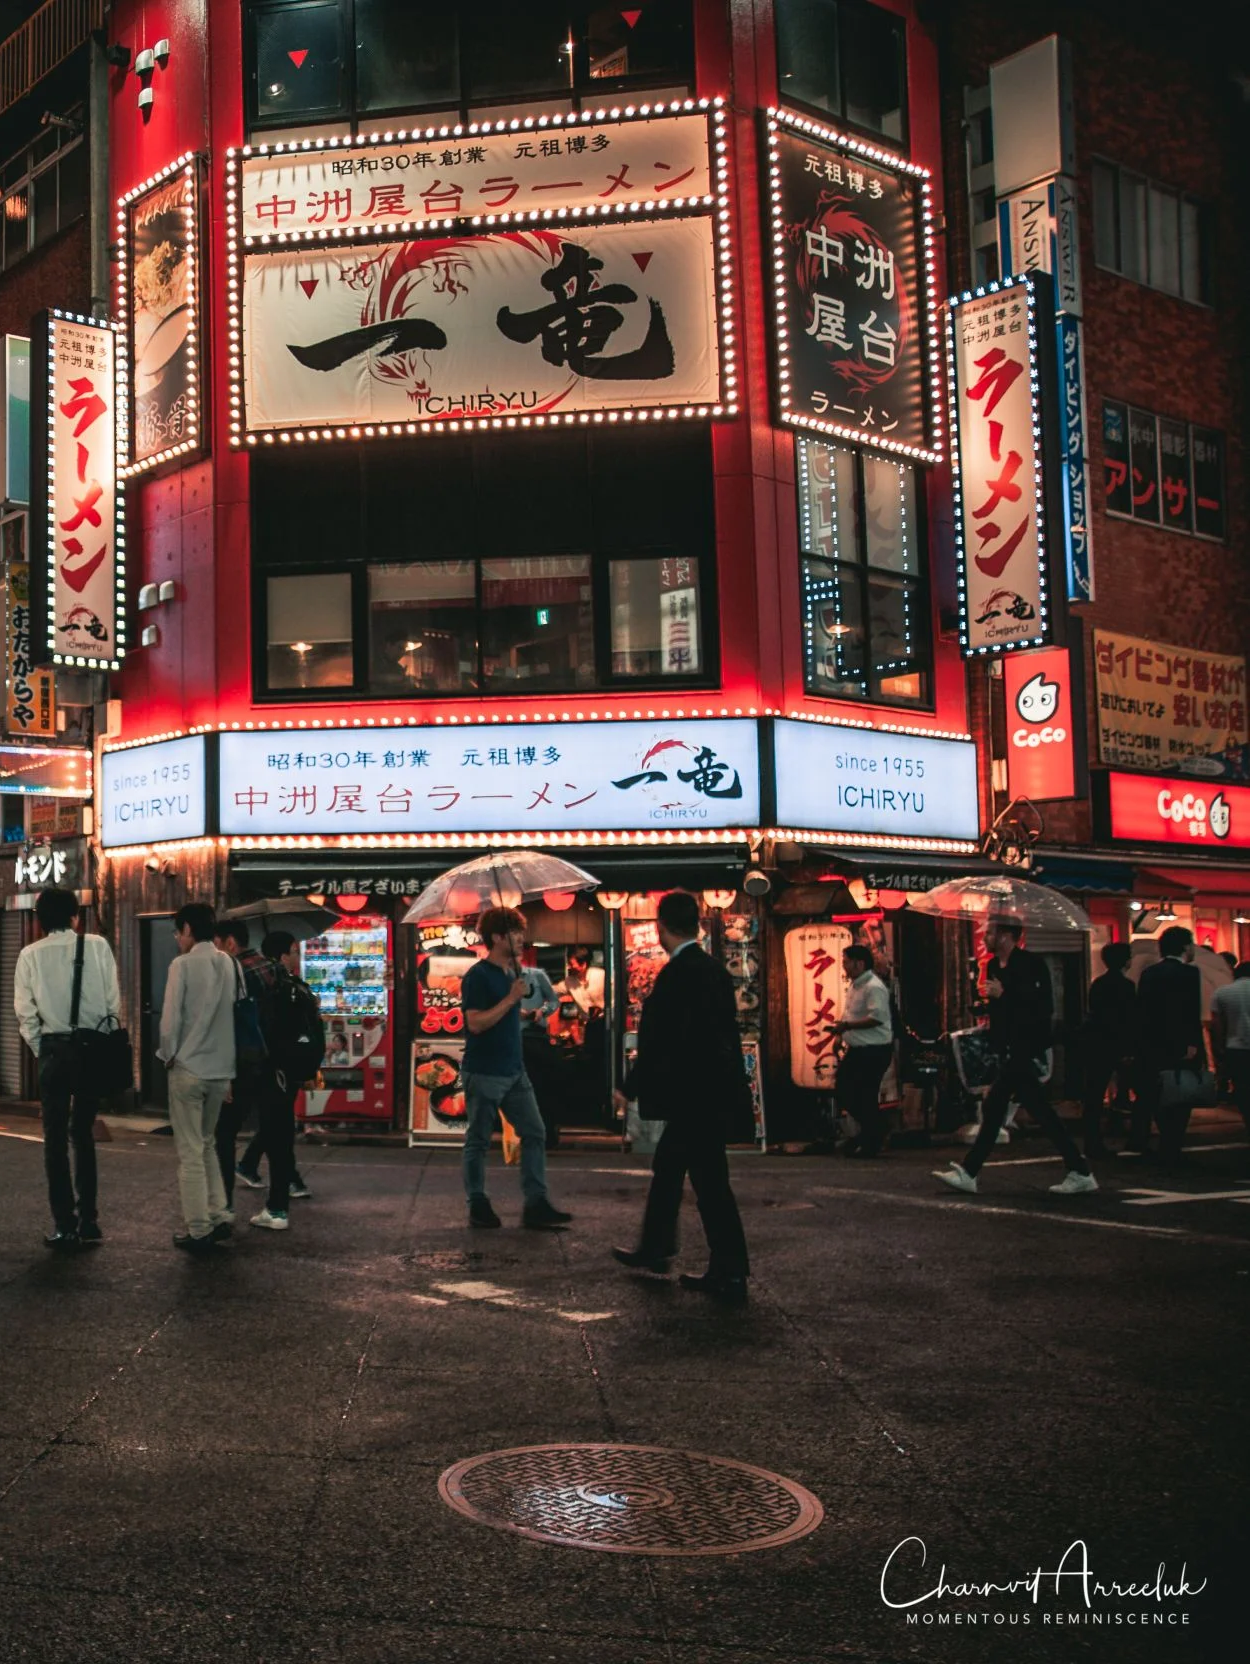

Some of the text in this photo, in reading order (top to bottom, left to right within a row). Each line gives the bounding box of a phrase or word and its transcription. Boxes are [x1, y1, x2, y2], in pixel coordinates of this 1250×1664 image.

[331, 131, 613, 176] 昭和30年創業 元祖博多
[255, 159, 697, 229] 中洲屋台ラーメン
[803, 153, 885, 201] 元祖博多
[805, 224, 896, 301] 中洲
[286, 241, 677, 381] 一竜
[805, 291, 897, 368] 屋台
[963, 304, 1022, 333] 元祖博多
[59, 338, 108, 358] 元祖博多
[962, 319, 1022, 347] 中洲屋台
[59, 353, 108, 373] 中洲屋台
[417, 390, 539, 416] ICHIRYU
[810, 389, 900, 434] ラーメン
[966, 347, 1030, 578] ラーメン
[1063, 330, 1088, 554] ダイビング ショップ
[59, 376, 108, 594] ラーメン
[1104, 456, 1220, 516] アンサー
[11, 604, 35, 730] おたからや
[1096, 639, 1245, 697] ダイビング器材が
[1172, 693, 1246, 733] 安いお店
[1012, 726, 1067, 748] CoCo
[113, 763, 192, 791] since 1955
[267, 745, 563, 772] 昭和30年創業 元祖博多
[611, 745, 744, 799] 一竜
[835, 753, 926, 778] since 1955
[113, 793, 191, 824] ICHIRYU
[234, 781, 598, 817] 中洲屋台ラーメン
[649, 807, 708, 821] ICHIRYU
[837, 784, 926, 814] ICHIRYU
[1157, 789, 1207, 823] CoCo
[804, 947, 836, 1056] ラーメン
